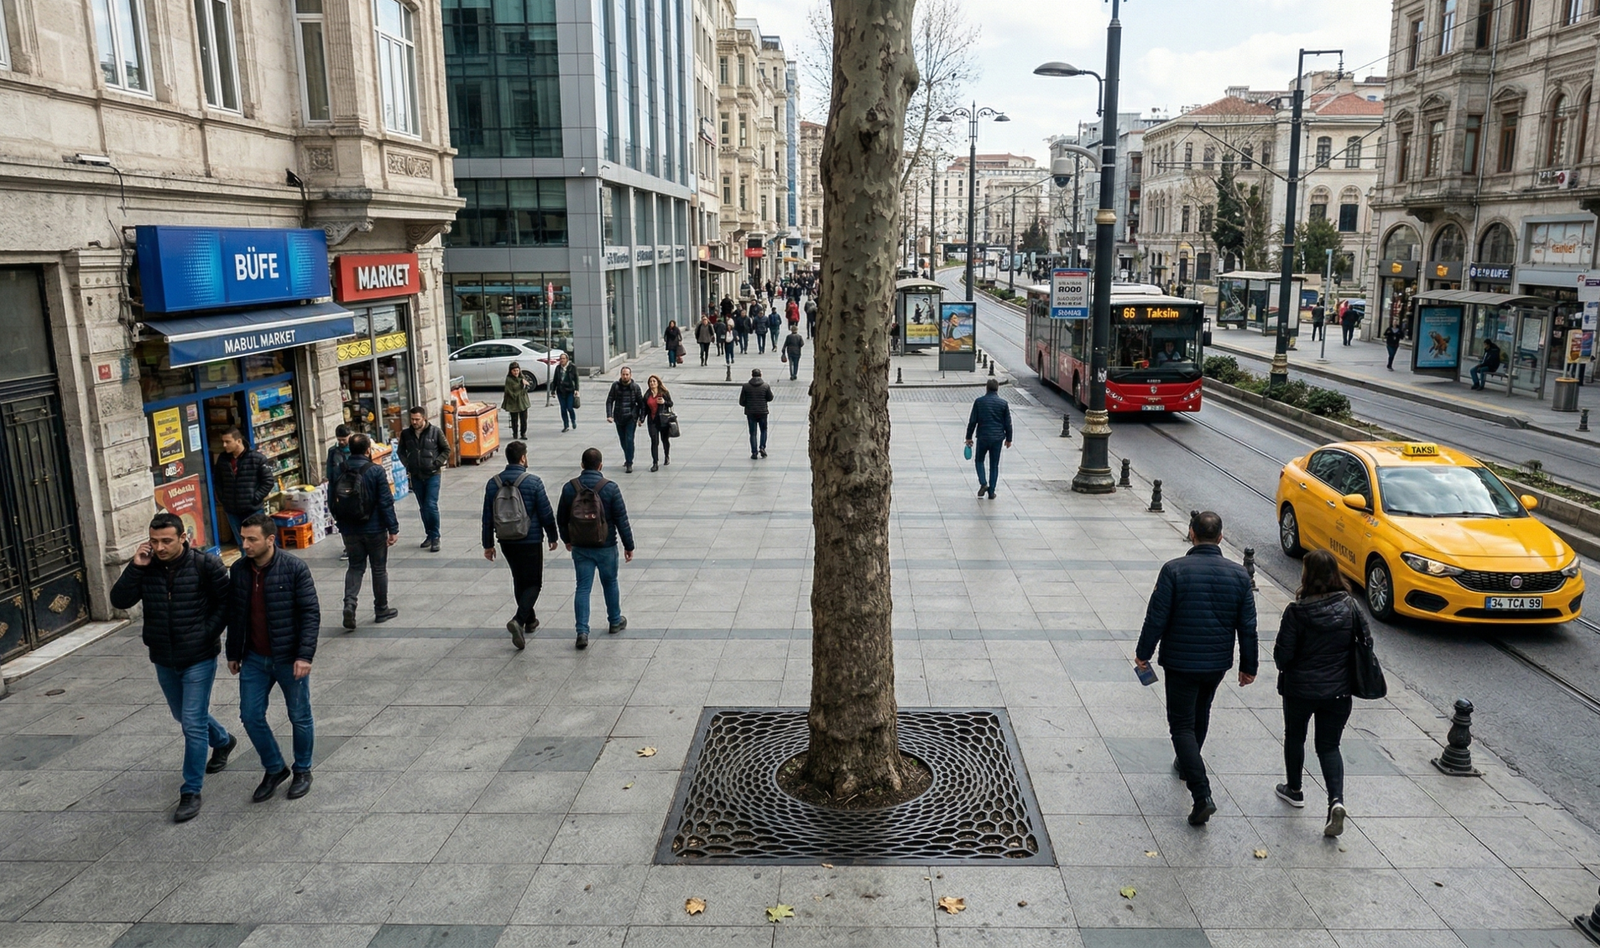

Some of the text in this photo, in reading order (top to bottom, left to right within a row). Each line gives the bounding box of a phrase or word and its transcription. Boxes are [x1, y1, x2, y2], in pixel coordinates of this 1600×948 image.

[234, 246, 279, 281] BÜFE
[357, 263, 410, 290] MARKET
[1123, 307, 1179, 319] 66 Taksim
[224, 329, 296, 354] MABUL MARKET
[1411, 446, 1436, 454] TAKSI
[1491, 598, 1541, 608] 34 TCA 99
